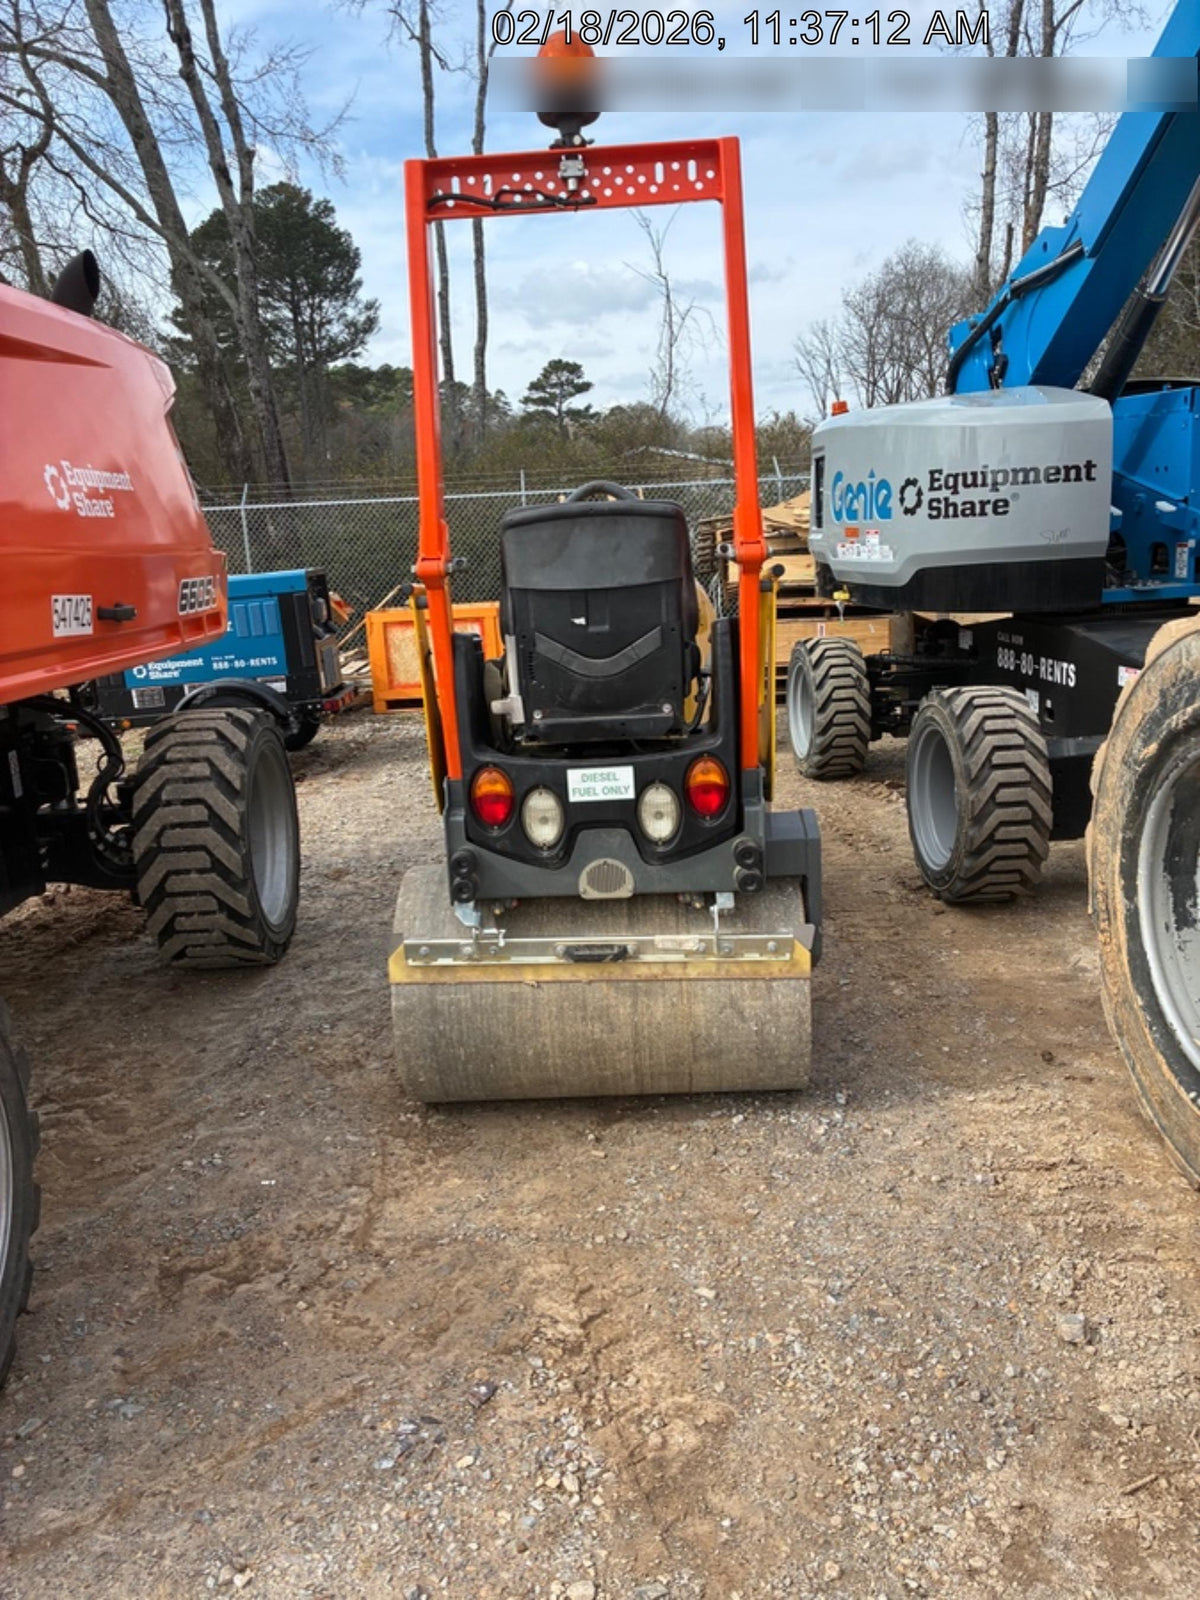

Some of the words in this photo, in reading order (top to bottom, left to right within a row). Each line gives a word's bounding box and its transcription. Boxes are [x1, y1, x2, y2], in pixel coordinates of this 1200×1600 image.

[60, 460, 134, 493] Equipment
[928, 459, 1097, 495] Equipment
[831, 469, 893, 523] Genie
[53, 597, 92, 629] 547425
[147, 657, 204, 670] Equipment
[212, 656, 278, 671] 888-80-RENTS
[997, 646, 1077, 688] 888-80-RENTS
[571, 787, 600, 797] FUEL
[601, 784, 631, 796] ONLY
[581, 771, 620, 783] DIESEL
